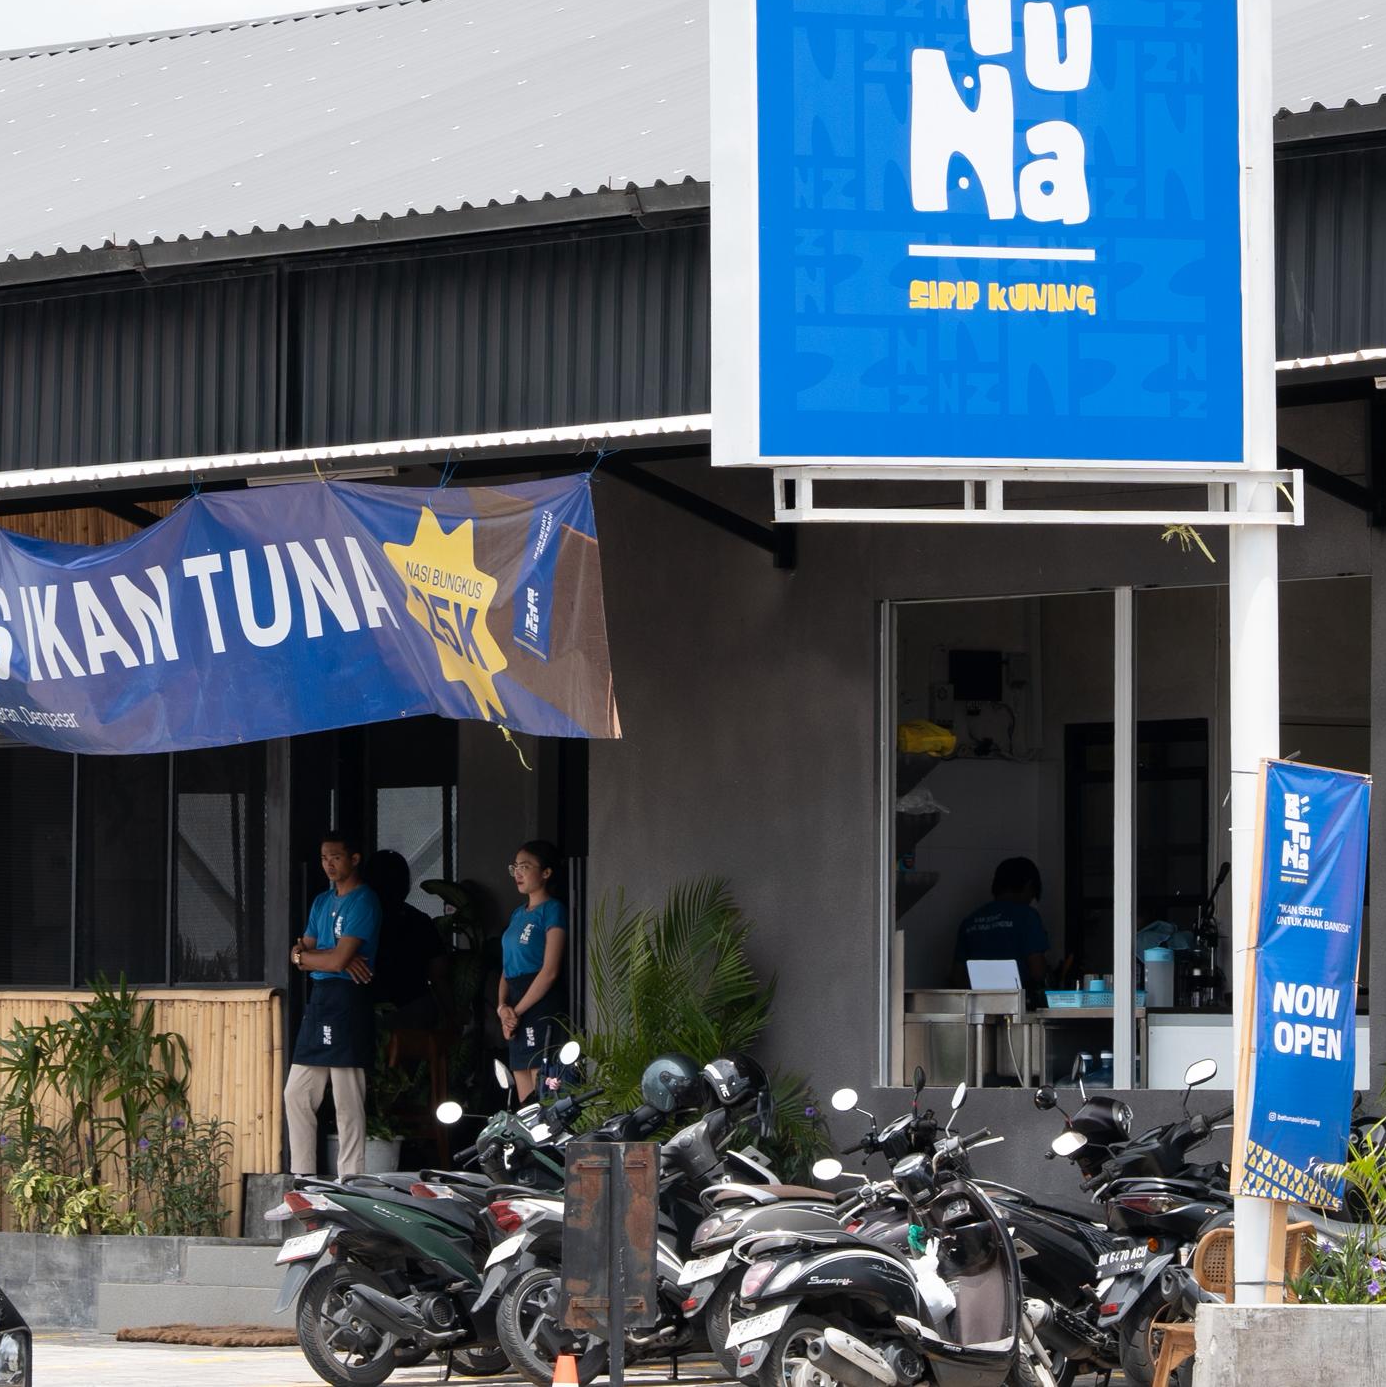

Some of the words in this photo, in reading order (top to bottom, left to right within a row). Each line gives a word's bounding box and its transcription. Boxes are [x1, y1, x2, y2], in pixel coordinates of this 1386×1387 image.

[909, 280, 980, 310] SIRIP
[988, 282, 1097, 316] KUNING
[405, 561, 431, 583] NASI
[432, 569, 483, 600] BUNGKUS
[19, 565, 179, 682] IKAN
[182, 536, 401, 654] TUNA
[409, 584, 490, 672] 25K
[19, 706, 81, 731] Denpasar
[1276, 916, 1302, 927] UNTUK
[1303, 918, 1323, 930] ANAK
[1298, 906, 1323, 917] SEHAT
[1273, 981, 1340, 1020] NOW
[1274, 1021, 1342, 1061] OPEN
[807, 1276, 853, 1286] Scoopy
